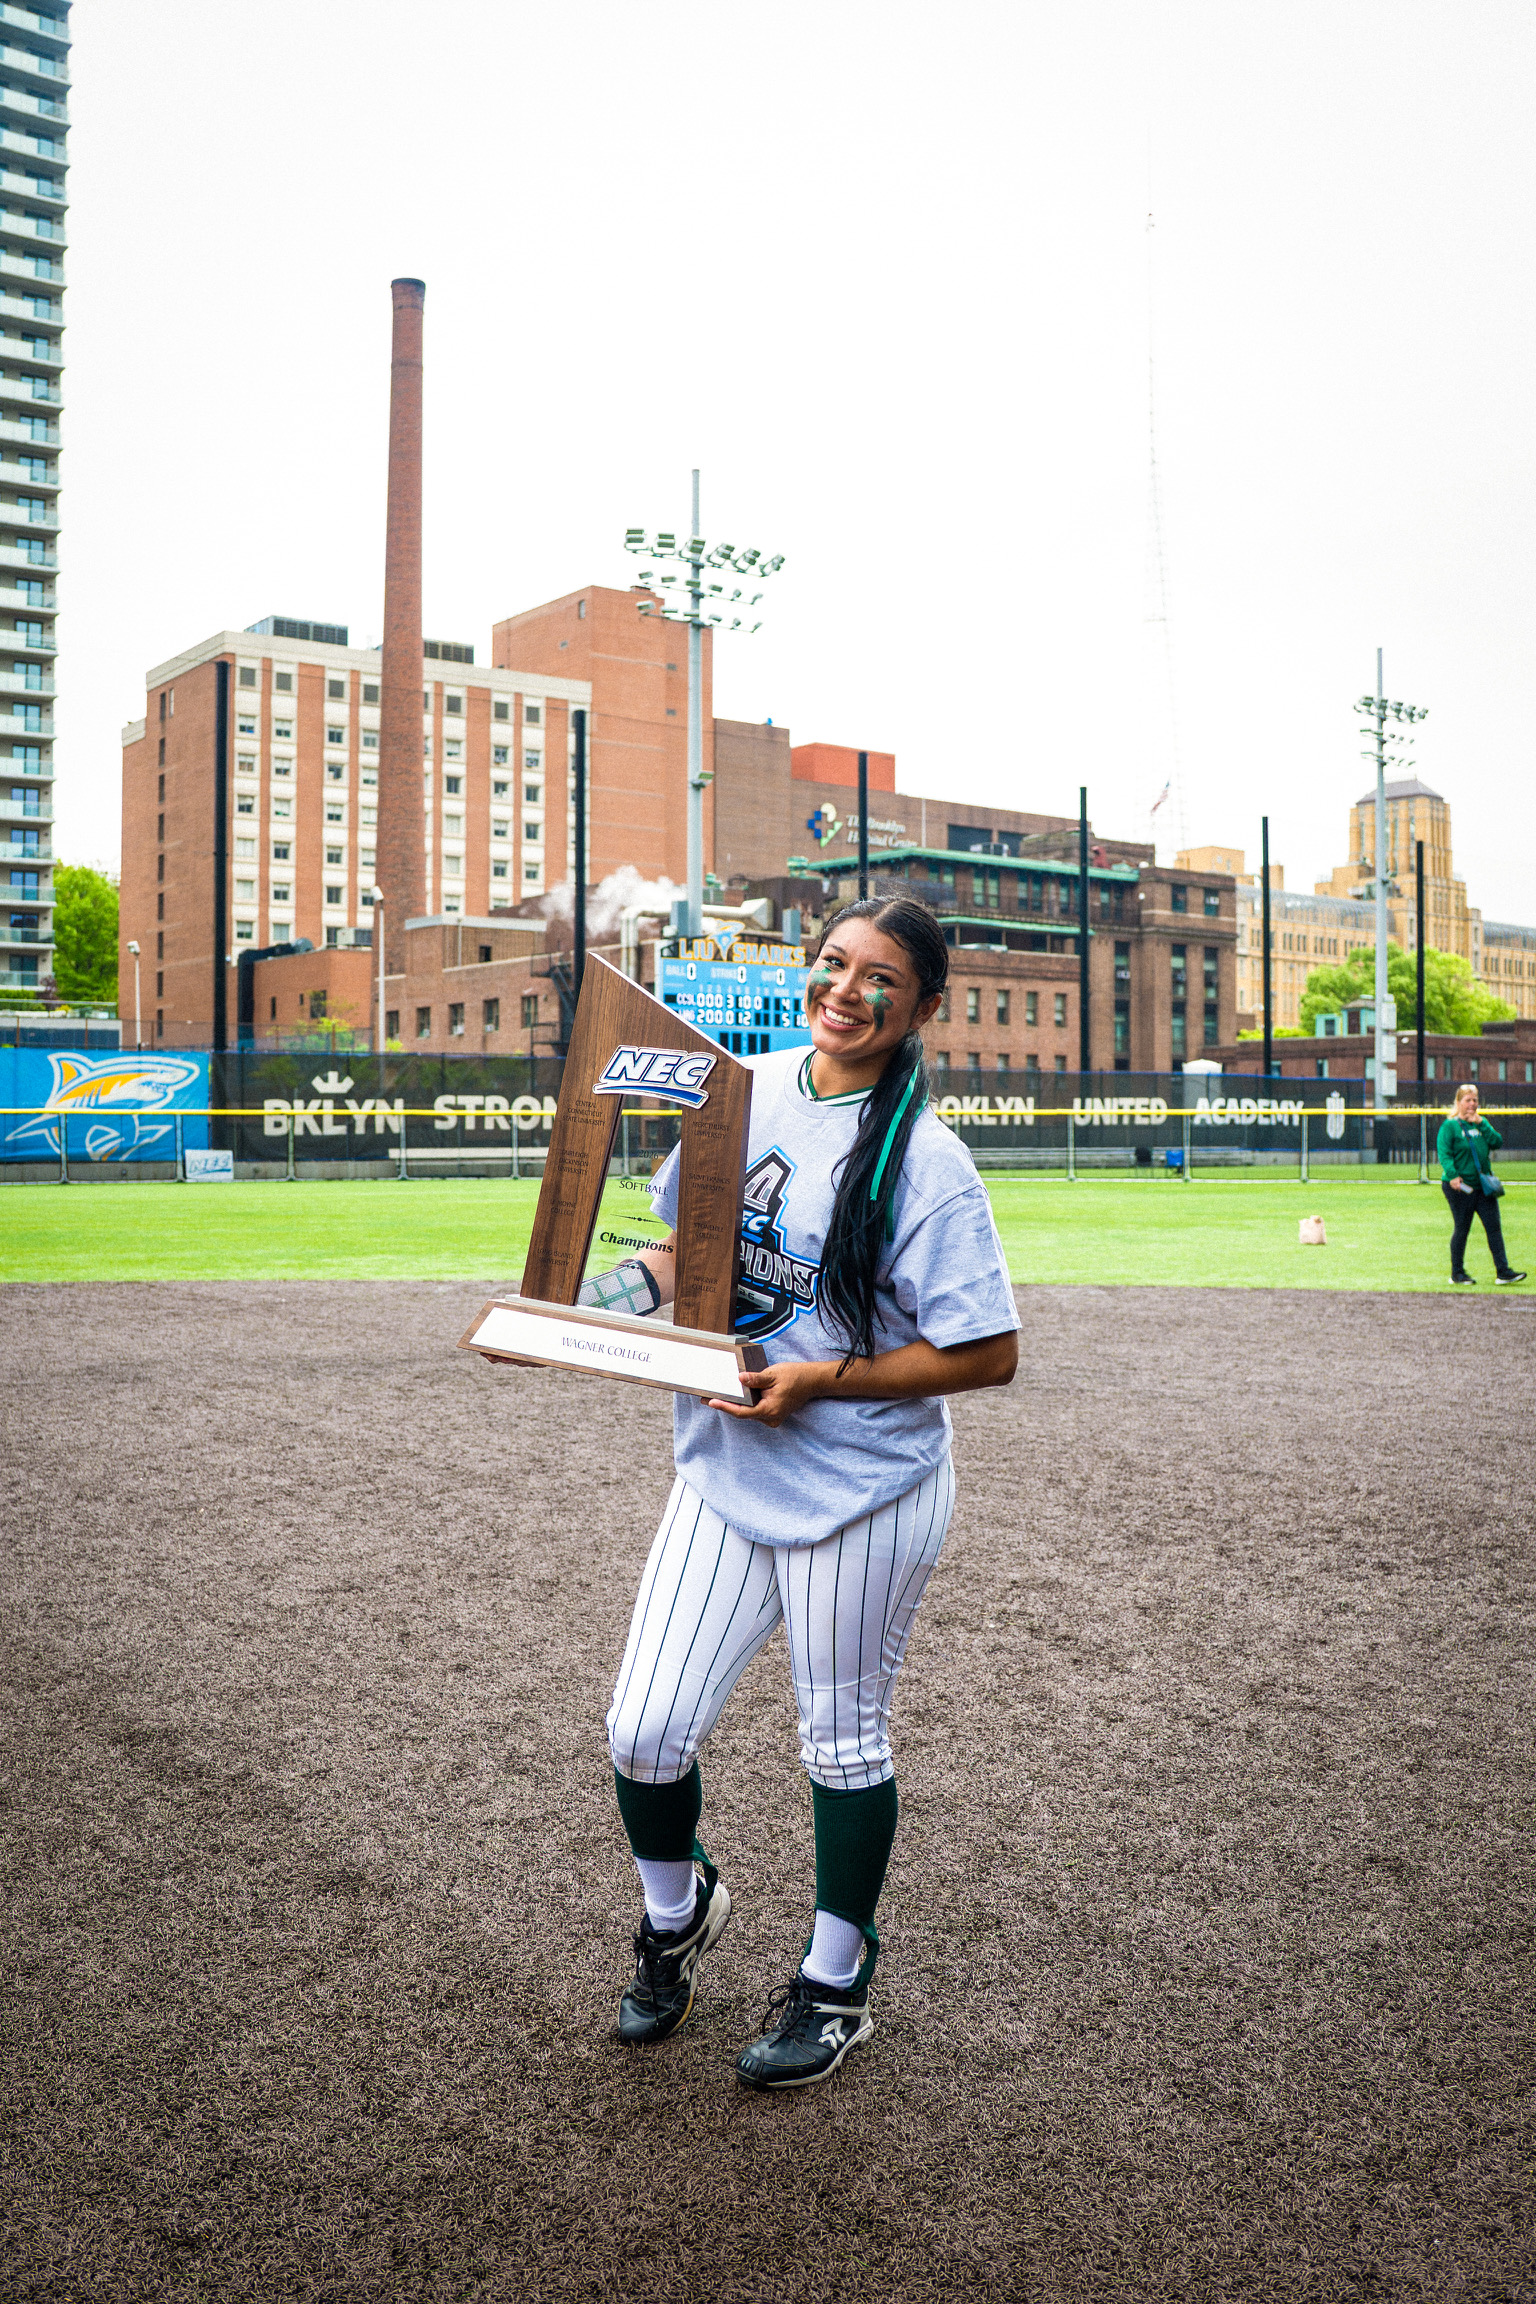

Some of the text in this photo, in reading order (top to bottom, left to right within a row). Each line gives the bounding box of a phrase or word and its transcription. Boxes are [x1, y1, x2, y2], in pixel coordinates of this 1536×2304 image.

[679, 938, 806, 966] LIU SHARKS
[604, 1050, 711, 1088] NEC
[264, 1098, 405, 1136] BKLYN
[930, 1095, 1304, 1126] OKLYN UNITED ACADEMY
[639, 1149, 659, 1160] 2026
[618, 1180, 668, 1196] SOFTBALL
[600, 1231, 674, 1254] Champions
[562, 1336, 652, 1363] WAGNER COLLEGE
